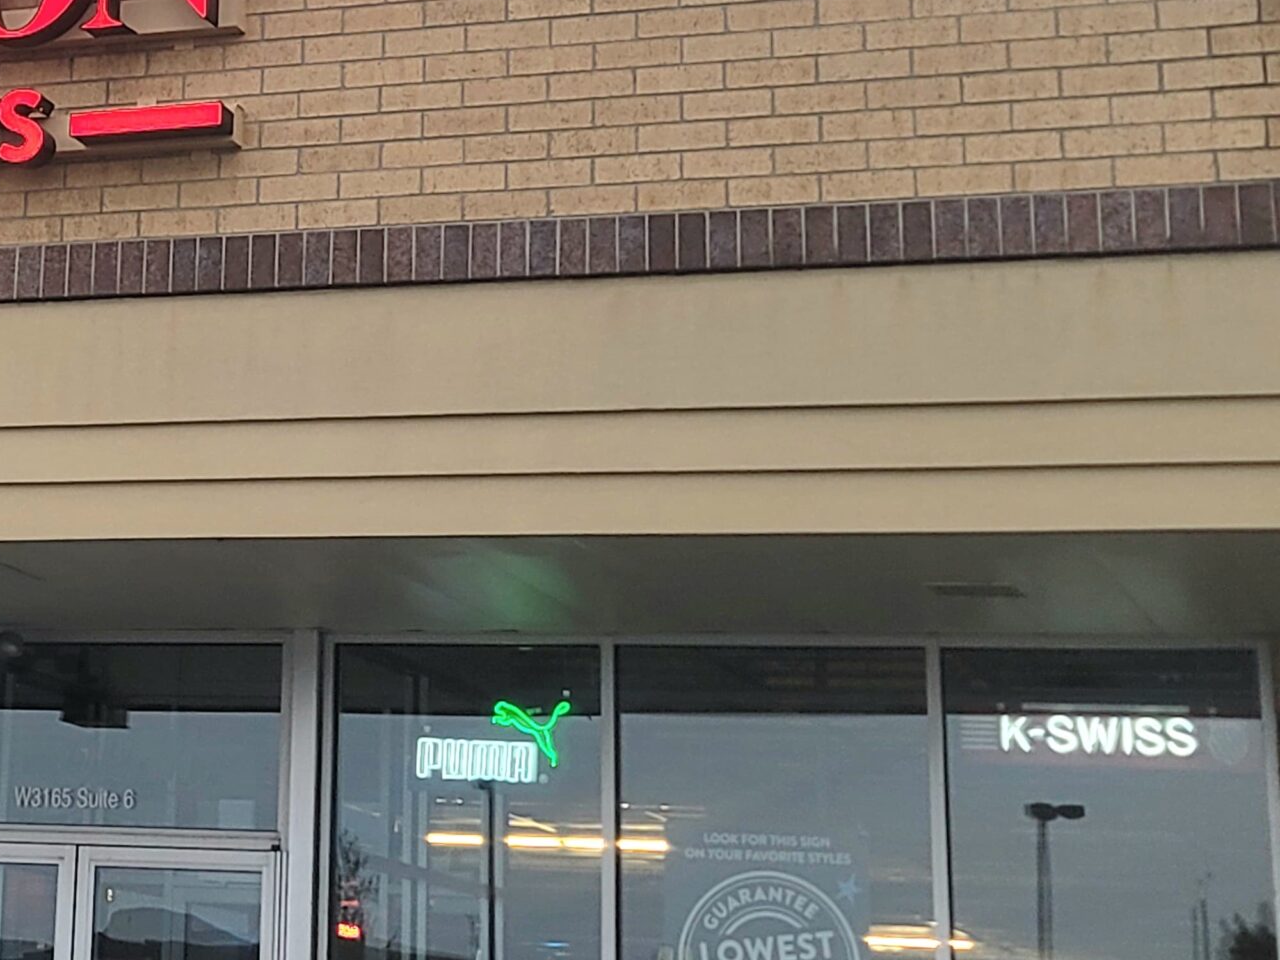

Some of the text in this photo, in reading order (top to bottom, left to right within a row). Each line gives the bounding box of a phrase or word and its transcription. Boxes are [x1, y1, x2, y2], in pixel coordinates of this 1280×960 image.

[999, 714, 1199, 757] K-SWISS
[416, 736, 538, 783] PUMA
[14, 785, 135, 809] W3165 Suite 6
[703, 833, 830, 848] LOOK FOR THIS SIGN
[685, 847, 852, 865] ON YOUR FAVORITE STYLES
[703, 886, 819, 930] GUARANTEE
[699, 930, 834, 960] LOWEST
